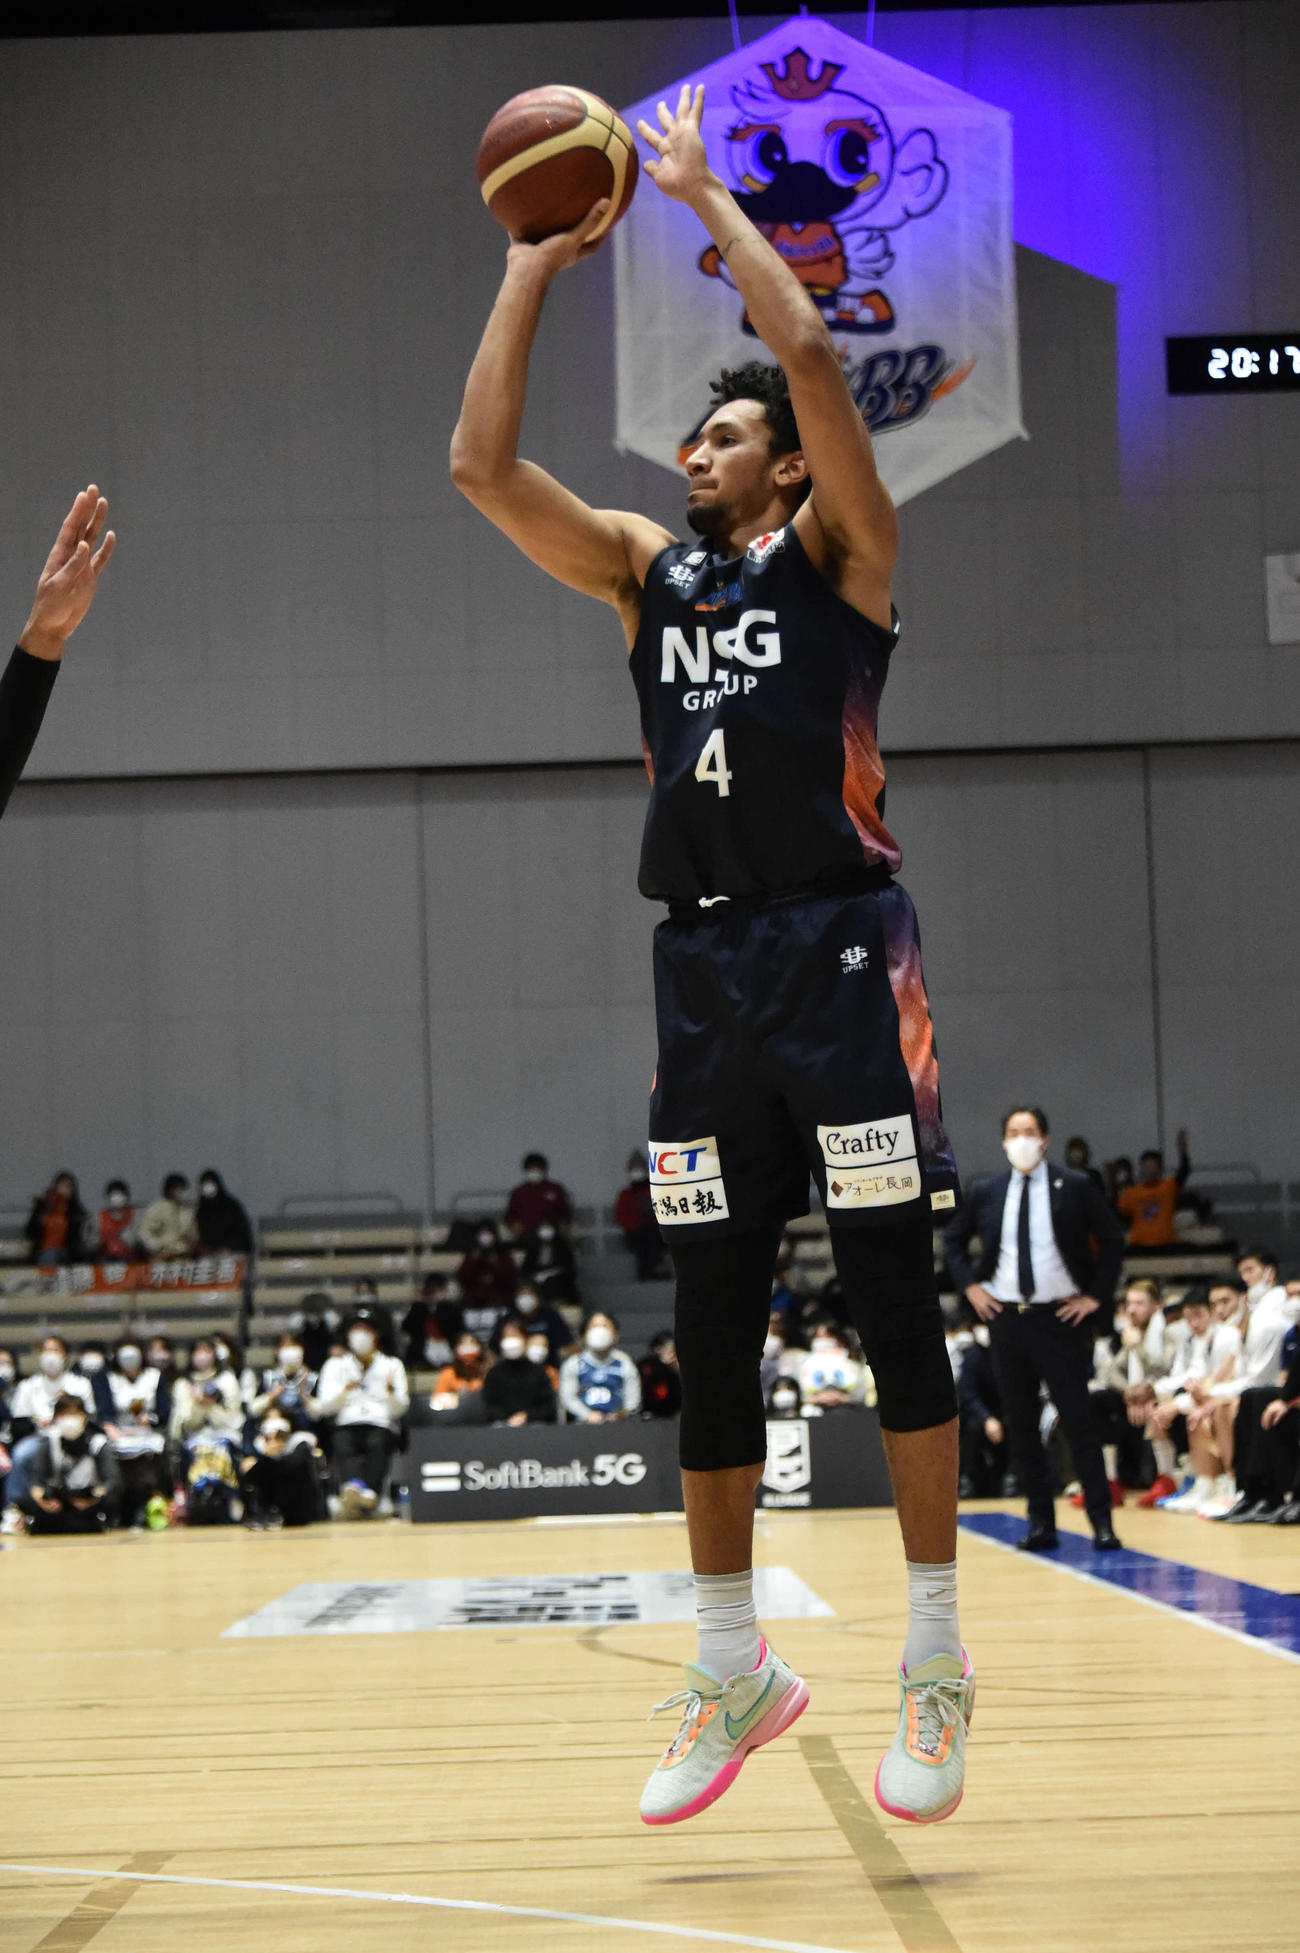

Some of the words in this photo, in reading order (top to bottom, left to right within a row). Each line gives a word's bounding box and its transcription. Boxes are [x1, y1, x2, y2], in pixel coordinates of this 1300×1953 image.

[682, 674, 758, 711] GRUP
[695, 728, 732, 797] 4
[842, 961, 869, 974] UPSET
[826, 1128, 899, 1157] Crafty
[843, 1176, 913, 1196] アオーレ長岡
[463, 1459, 590, 1491] SoftBank
[591, 1453, 647, 1486] 5G
